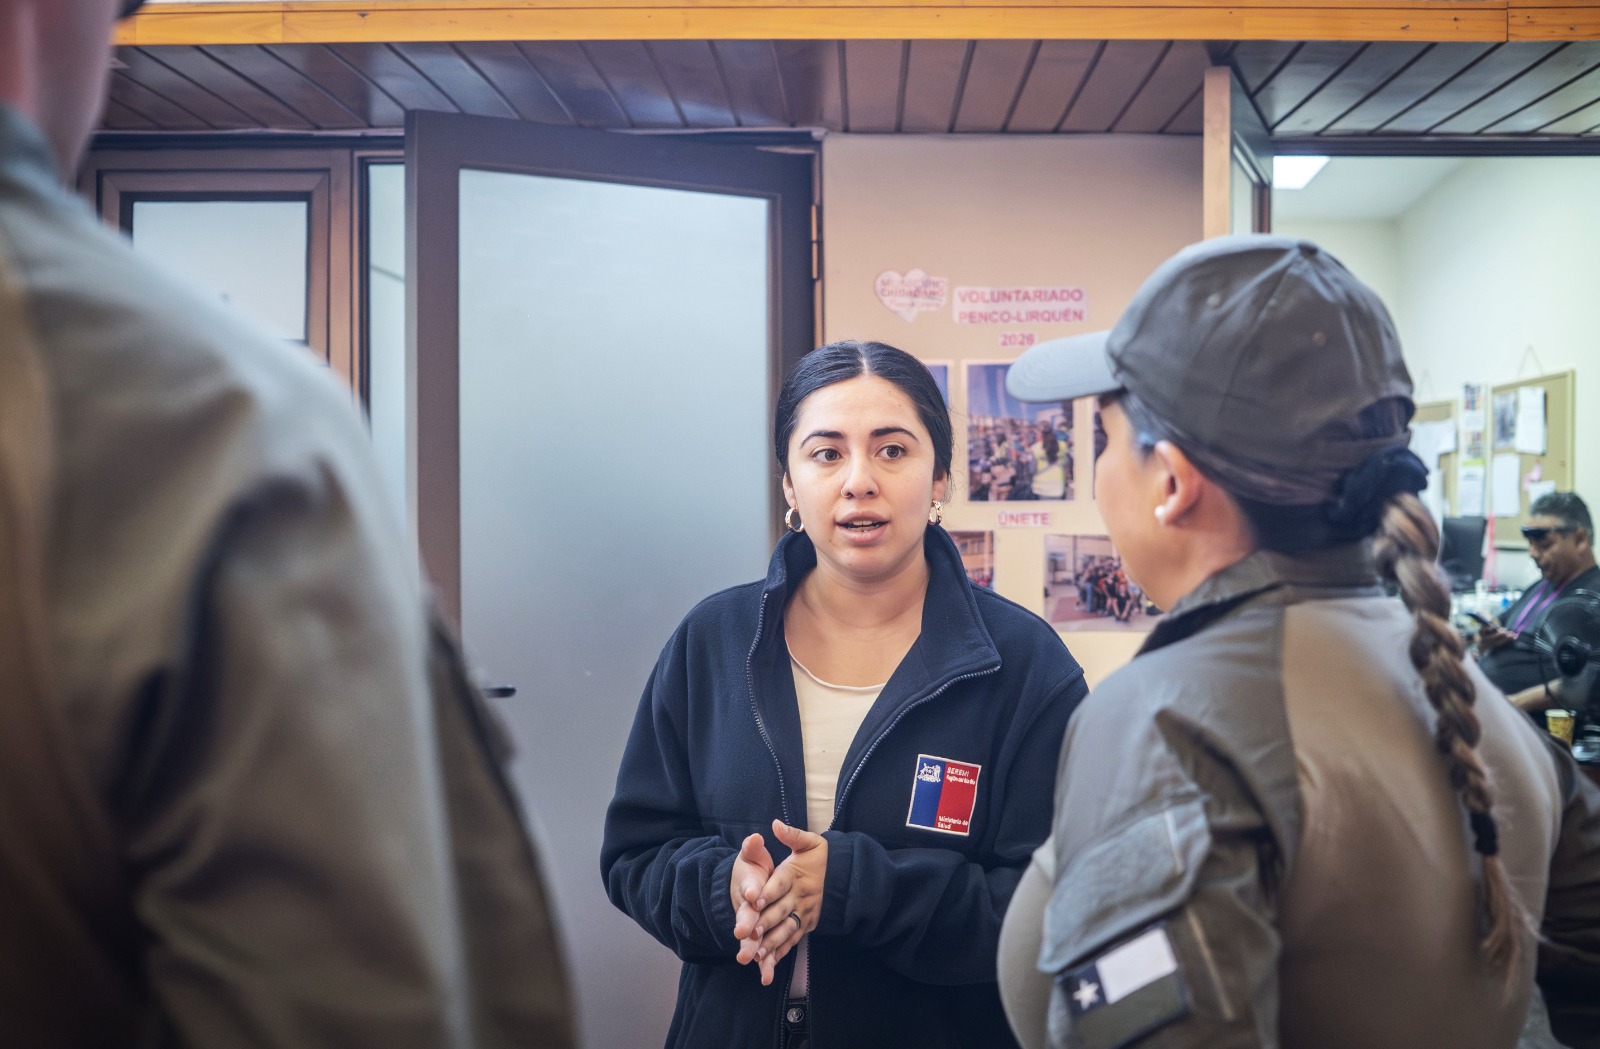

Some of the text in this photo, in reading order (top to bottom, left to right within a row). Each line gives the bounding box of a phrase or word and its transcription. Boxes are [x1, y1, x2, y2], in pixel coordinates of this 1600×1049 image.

[958, 288, 1084, 303] VOLUNTARIADO
[959, 308, 1084, 323] PENCO-LIRQUÉN
[998, 510, 1050, 525] ÚNETE
[947, 767, 969, 777] SEREMI
[939, 816, 961, 824] Ministerio
